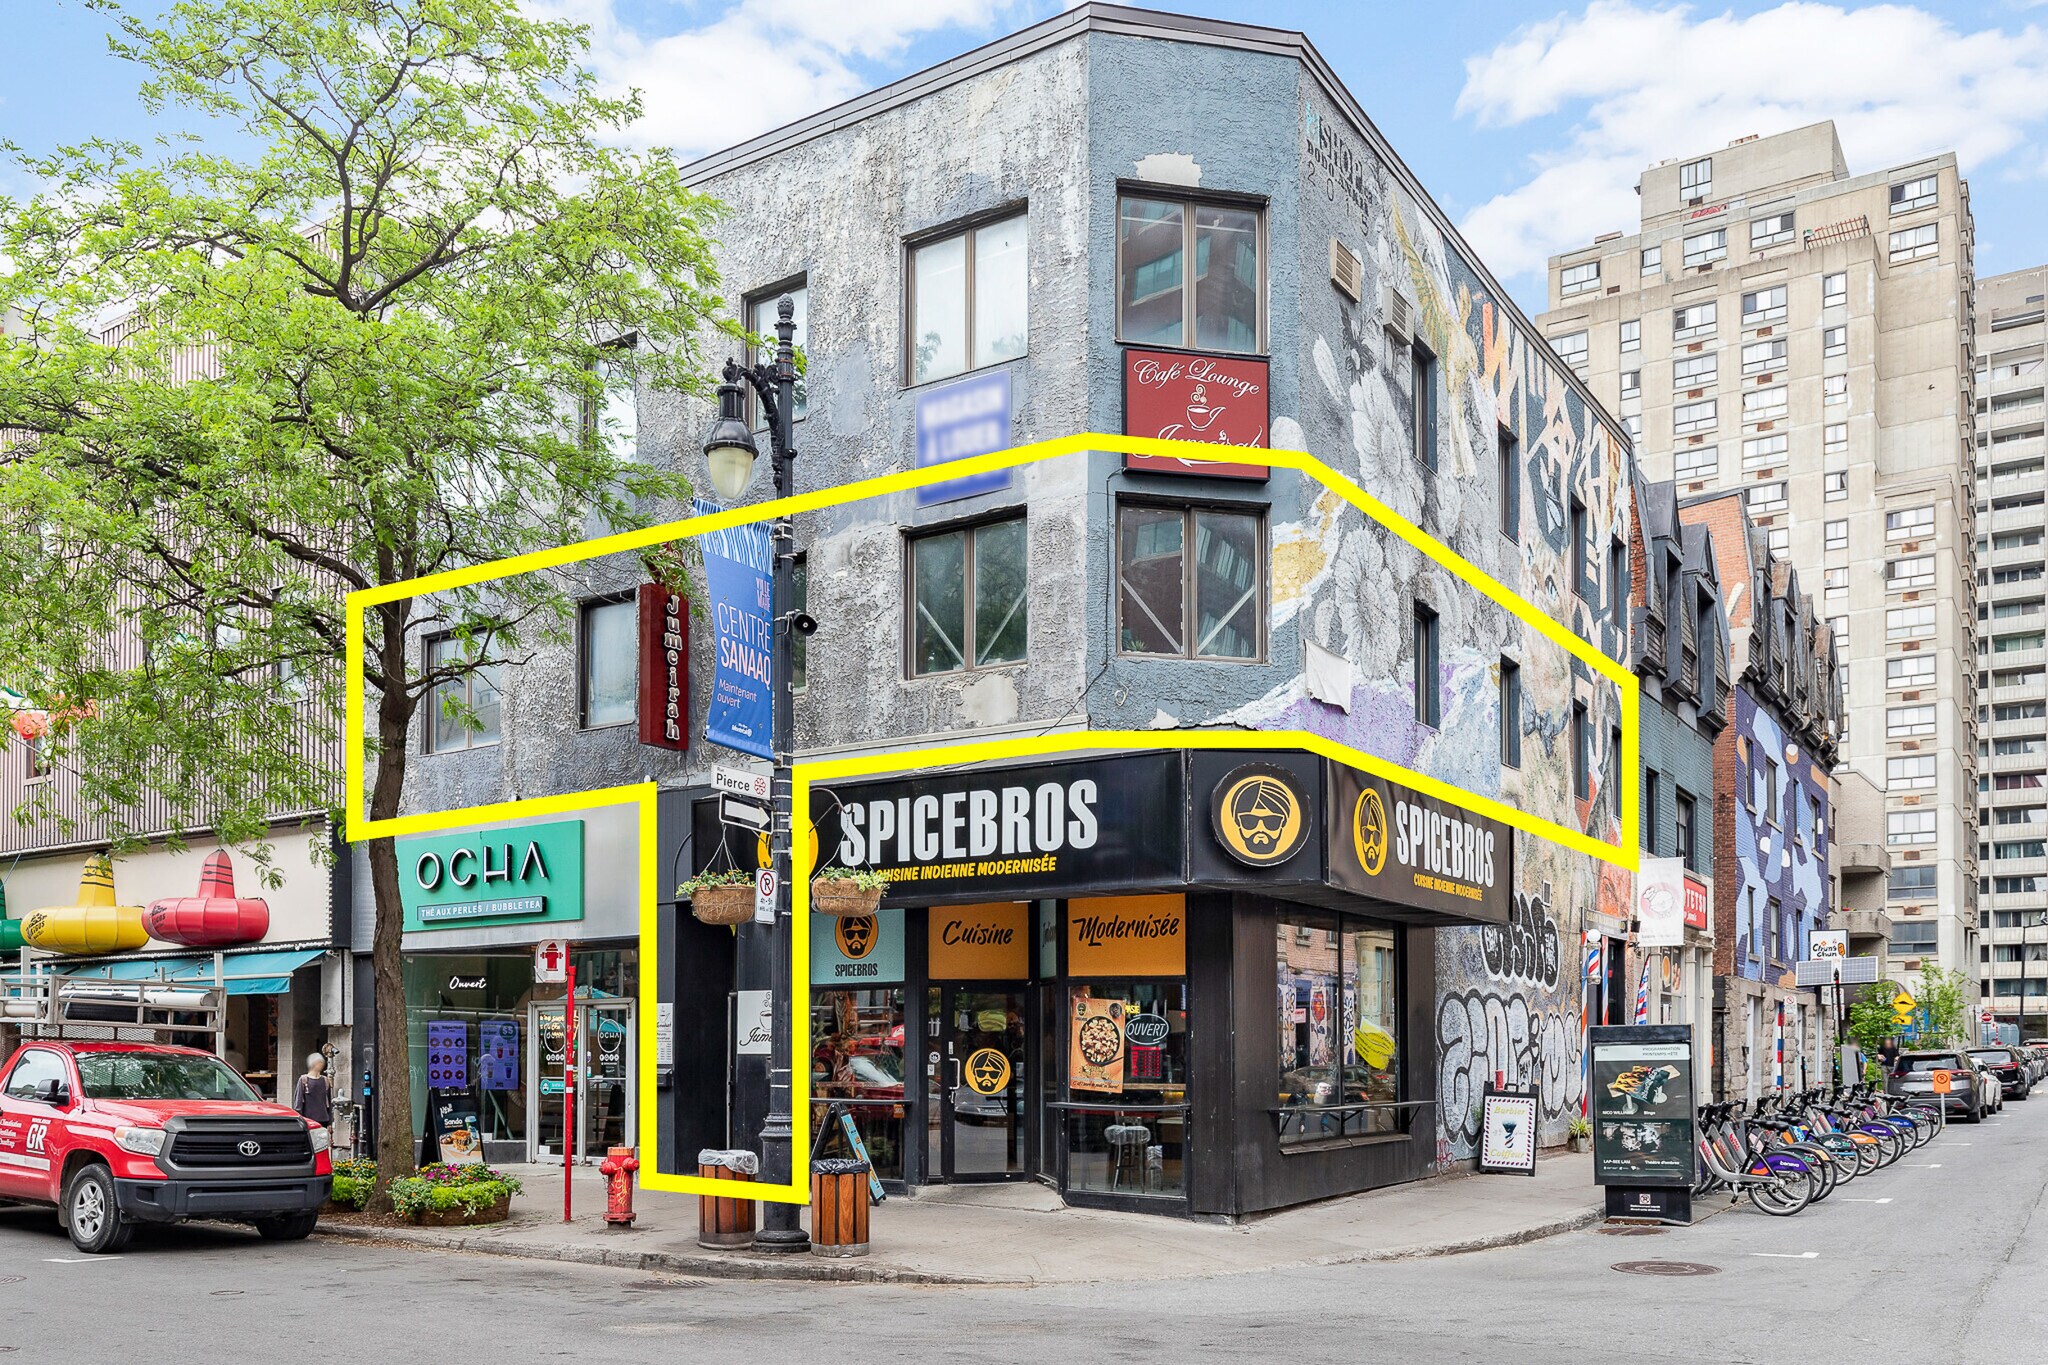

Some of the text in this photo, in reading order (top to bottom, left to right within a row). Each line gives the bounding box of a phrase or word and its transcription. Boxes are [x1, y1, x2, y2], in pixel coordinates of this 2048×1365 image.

[1133, 358, 1260, 398] Café Lounge
[717, 602, 771, 653] CENTRE
[663, 594, 683, 741] Jumeirah
[720, 636, 772, 691] SANAAQ
[717, 692, 741, 709] ouvert
[718, 678, 757, 703] Maintenant
[716, 773, 750, 792] Pierce
[839, 779, 1098, 867] SPICEBROS
[1395, 800, 1495, 888] SPICEBROS
[415, 840, 550, 890] OCHA
[920, 860, 975, 879] INDIENNE
[976, 854, 1057, 876] MODERNISÉE
[1413, 873, 1433, 890] CUISINE
[421, 907, 435, 917] THÉ
[436, 905, 451, 915] AUX
[452, 903, 483, 915] PERLES
[491, 901, 523, 911] BUBBLE
[525, 900, 542, 909] TEA
[942, 920, 1014, 946] Cuisine
[1071, 913, 1180, 947] Modernisée
[449, 976, 487, 990] Ouvert
[834, 963, 878, 978] SPICEBROS
[600, 1031, 620, 1039] OCHA
[1127, 1023, 1166, 1038] OUVERT
[1493, 1105, 1526, 1116] Barbier
[26, 1123, 48, 1150] GR
[1489, 1148, 1525, 1159] Coiffeur
